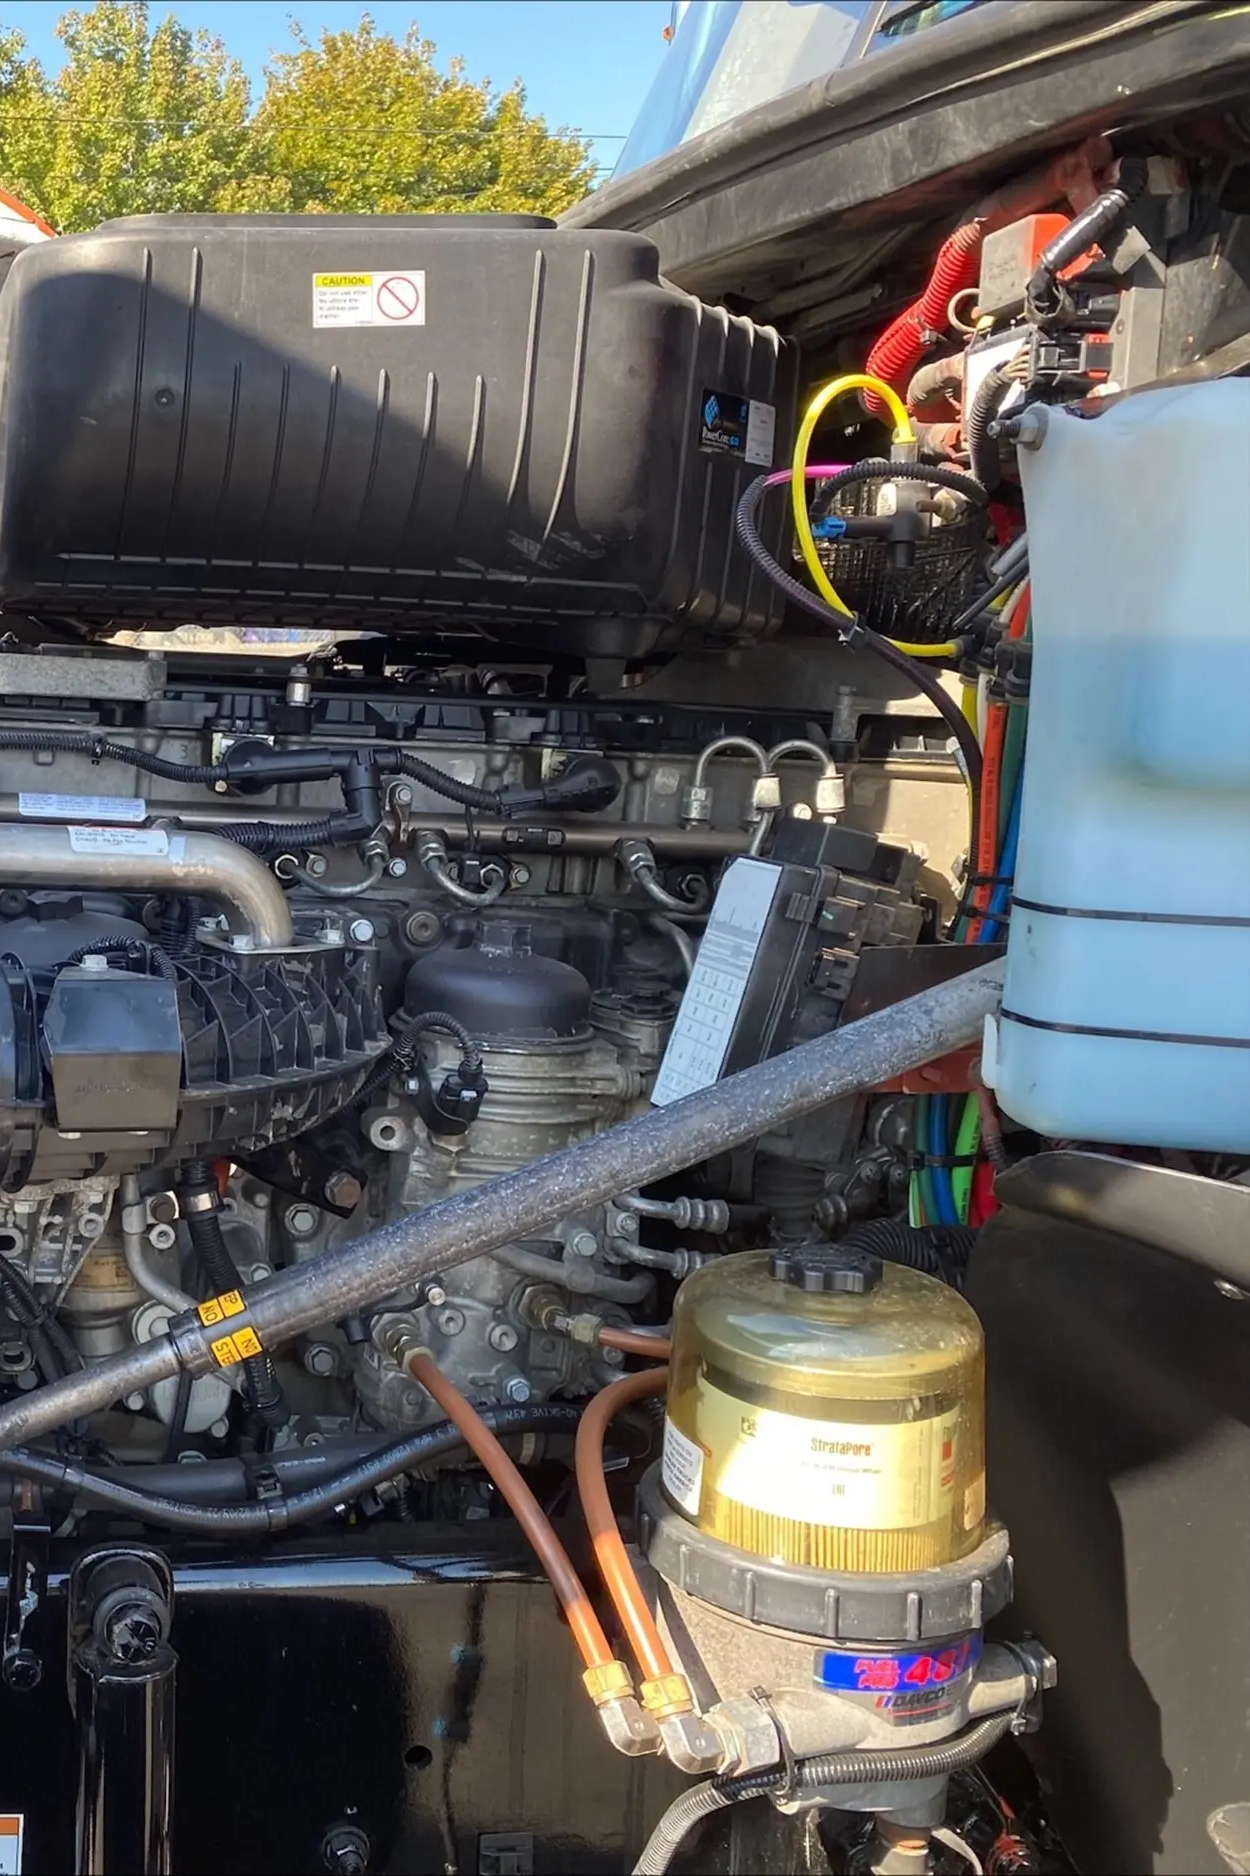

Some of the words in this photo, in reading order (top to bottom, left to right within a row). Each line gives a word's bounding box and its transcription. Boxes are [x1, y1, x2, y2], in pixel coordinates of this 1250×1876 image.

[321, 277, 365, 286] CAUTION
[201, 1304, 218, 1323] NO
[215, 1341, 236, 1365] STE
[810, 1437, 871, 1457] StrataPore
[893, 1686, 945, 1708] DAVCO
